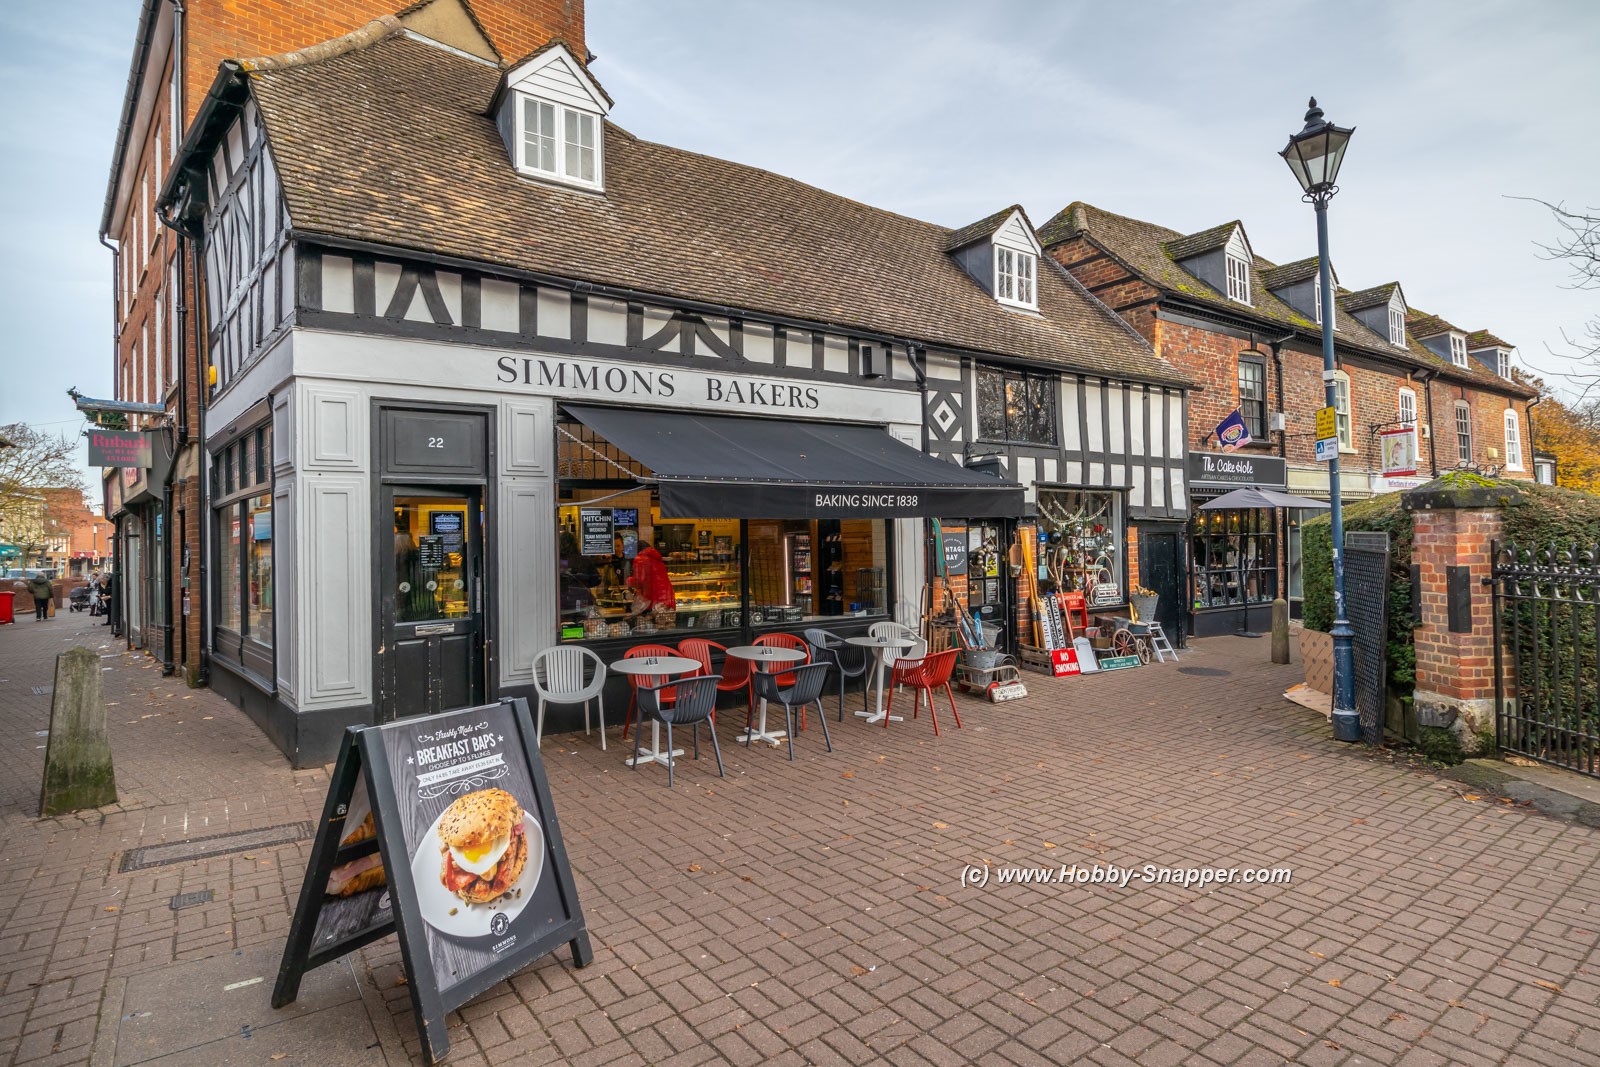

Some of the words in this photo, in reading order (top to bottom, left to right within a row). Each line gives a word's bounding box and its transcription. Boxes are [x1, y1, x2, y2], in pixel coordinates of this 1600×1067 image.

[497, 356, 675, 397] SIMMONS
[706, 378, 819, 410] BAKERS
[428, 437, 444, 448] 22
[1202, 457, 1215, 472] The
[1217, 459, 1235, 473] Cake
[1235, 460, 1254, 474] Hole
[815, 494, 860, 507] BAKING
[861, 495, 895, 507] SINCE
[896, 495, 918, 507] 1838
[1060, 652, 1069, 662] NO
[1055, 662, 1080, 674] SMOKING
[435, 728, 457, 740] Freshly
[457, 725, 473, 736] Made
[416, 739, 470, 765] BREAKFAST
[471, 733, 496, 752] BAPS
[428, 761, 450, 771] CHOOSE
[471, 749, 491, 760] FILLINGS
[423, 775, 435, 783] ONLY
[449, 768, 460, 776] TAKE
[461, 764, 475, 773] AWAY
